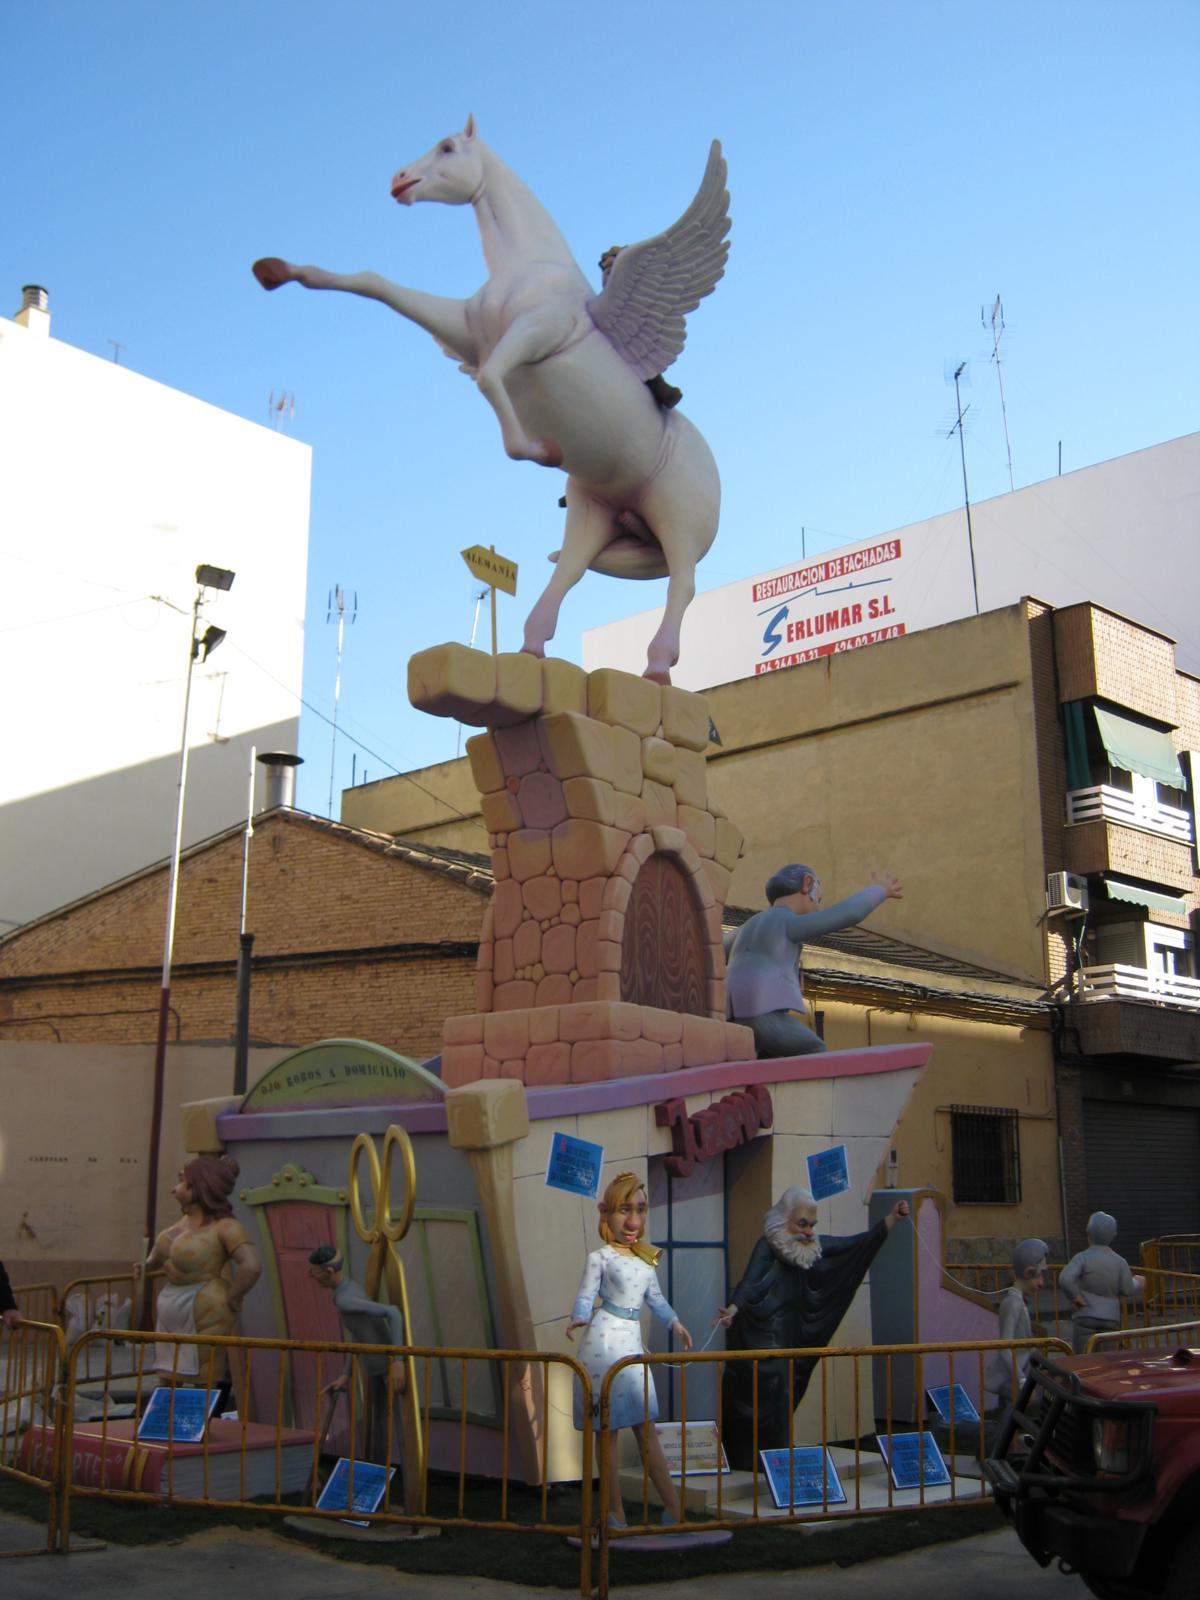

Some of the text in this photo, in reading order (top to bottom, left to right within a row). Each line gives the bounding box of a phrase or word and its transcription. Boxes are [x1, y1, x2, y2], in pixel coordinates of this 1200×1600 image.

[756, 542, 896, 600] RESTAURACION DE FACHADAS
[868, 595, 896, 619] S.L.
[328, 1067, 336, 1079] A
